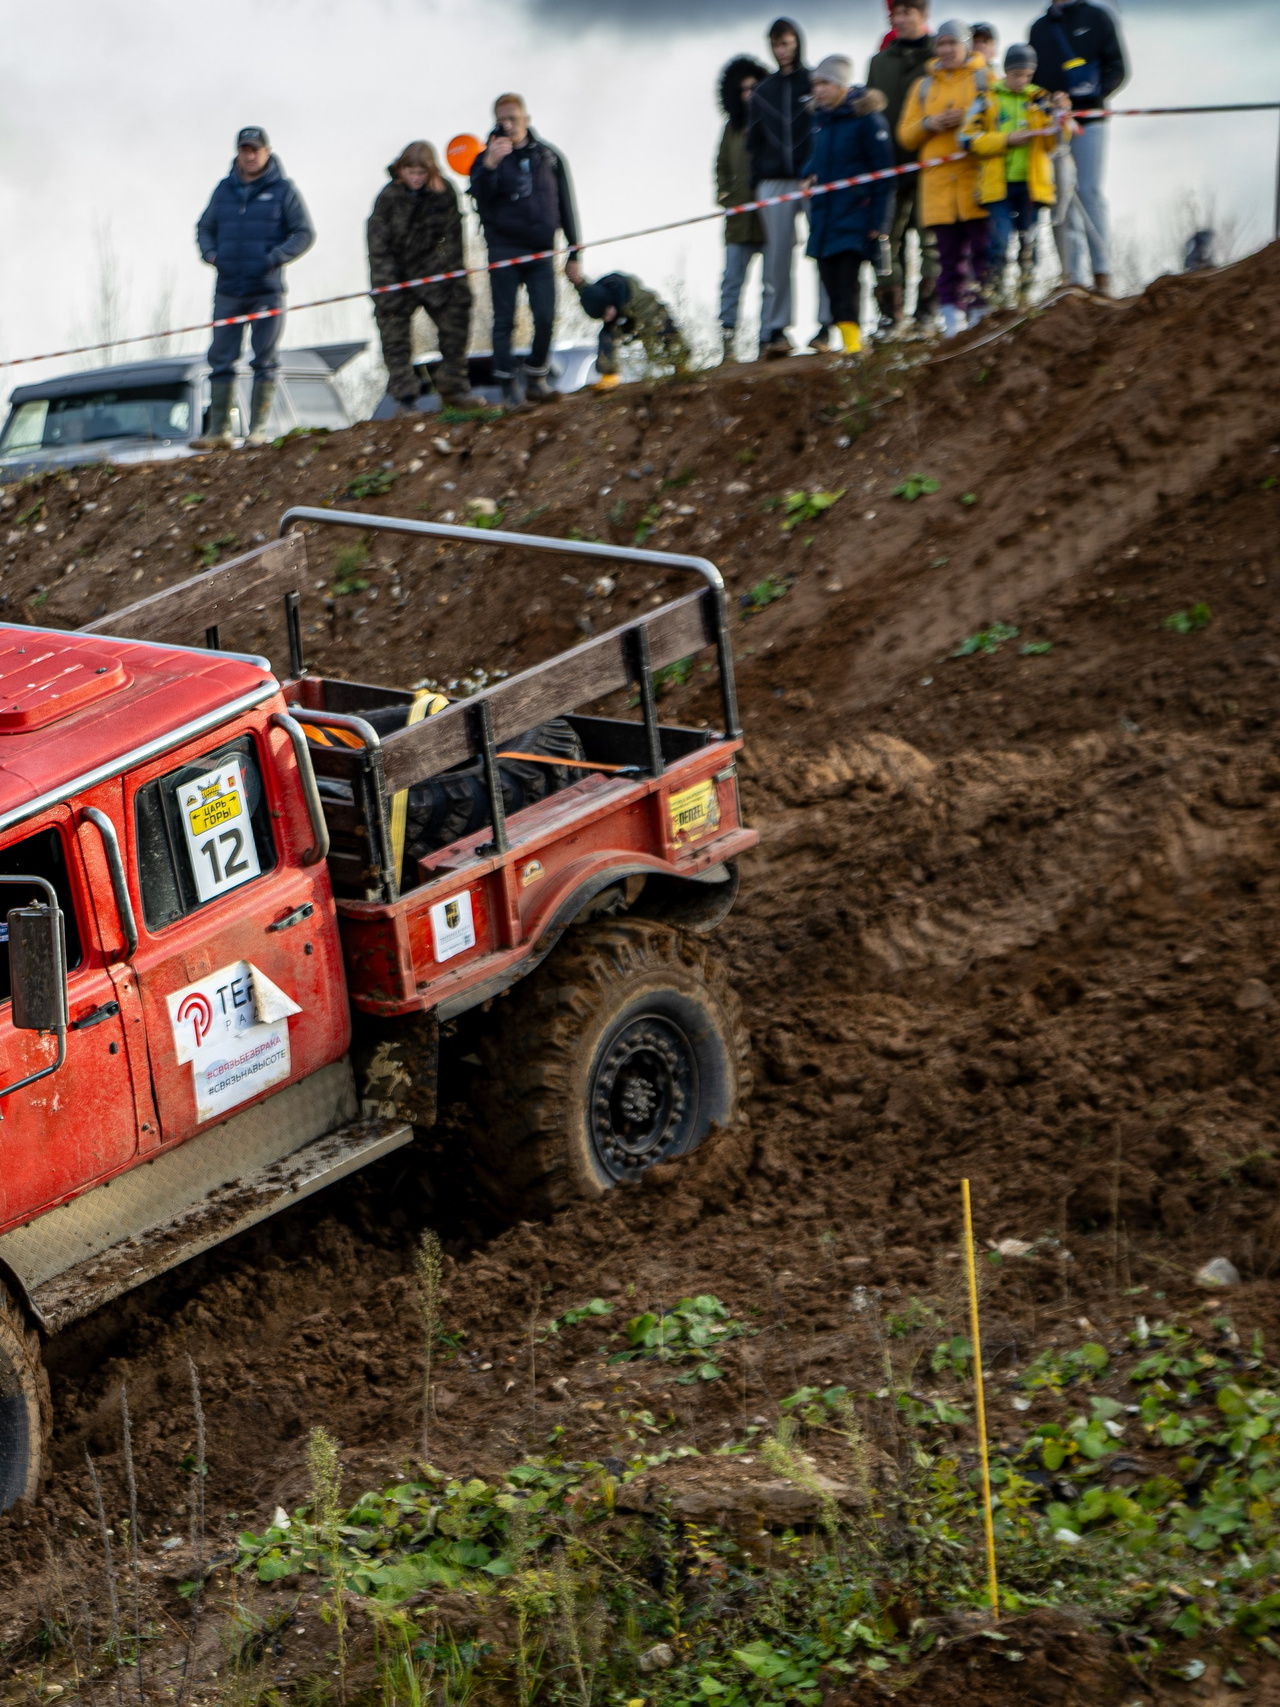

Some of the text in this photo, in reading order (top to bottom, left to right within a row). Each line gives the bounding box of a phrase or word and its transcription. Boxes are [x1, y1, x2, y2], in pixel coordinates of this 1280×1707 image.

[203, 800, 227, 817] ЦАРЬ
[203, 807, 232, 828] ГОРЫ
[201, 828, 250, 884] 12
[206, 1036, 282, 1081] #СВЯЗЬБЕЗБРАКА
[208, 1049, 287, 1096] #СВЯЗЬНАВЫСОТЕ
